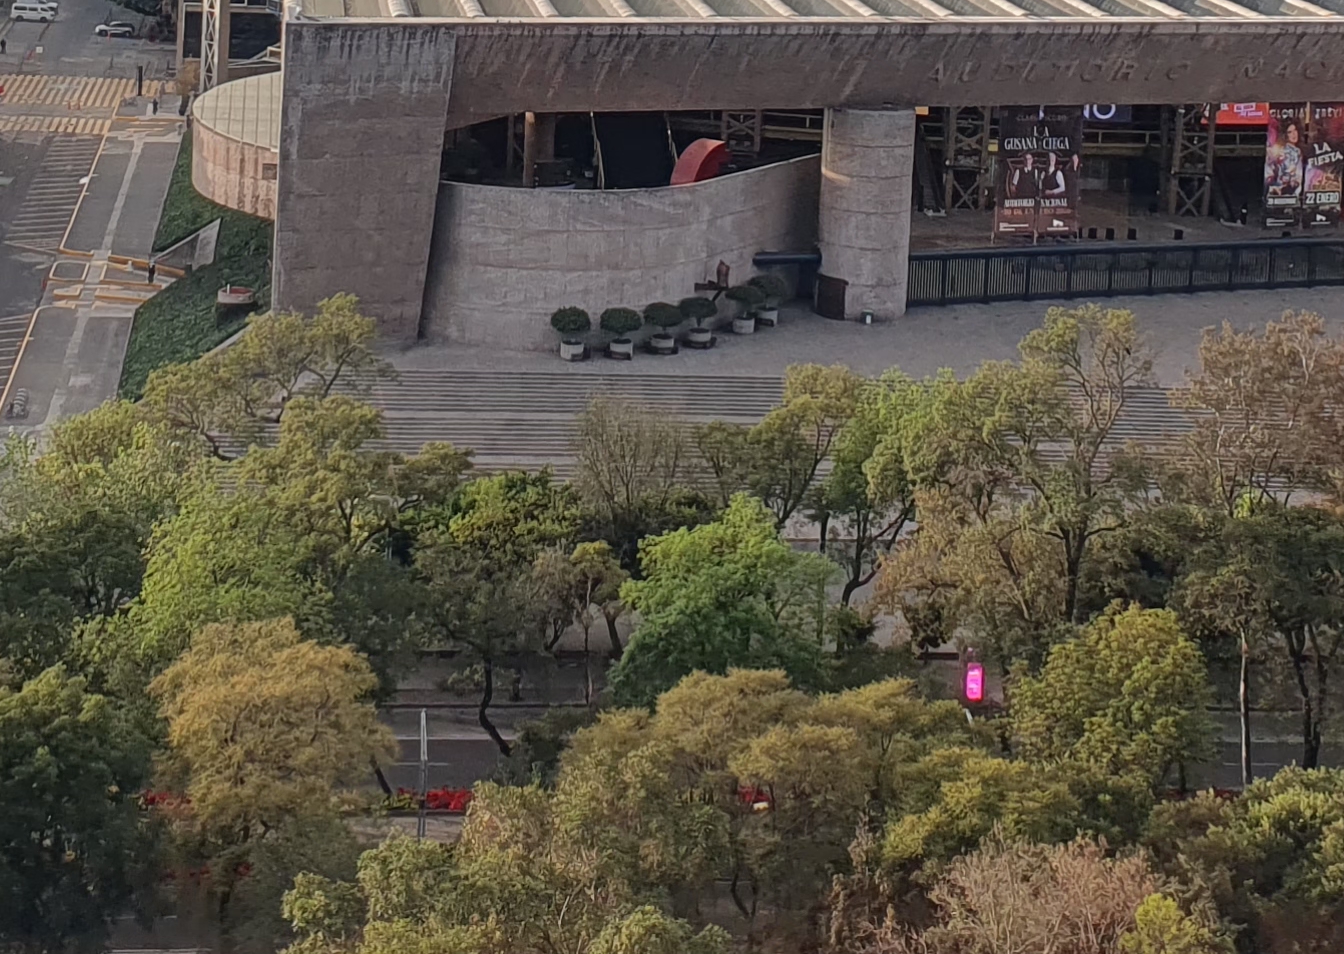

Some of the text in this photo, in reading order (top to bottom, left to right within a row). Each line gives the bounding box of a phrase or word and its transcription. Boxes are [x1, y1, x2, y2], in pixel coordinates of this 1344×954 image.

[927, 58, 1192, 85] AUDITORIO
[1269, 107, 1306, 118] GLORIA
[1314, 107, 1343, 119] TREVI
[1004, 137, 1070, 150] GUSANA CIEGA
[1313, 142, 1332, 154] LA
[1307, 151, 1344, 167] FIESTA
[1306, 192, 1315, 204] 22
[1316, 192, 1340, 204] ENERO
